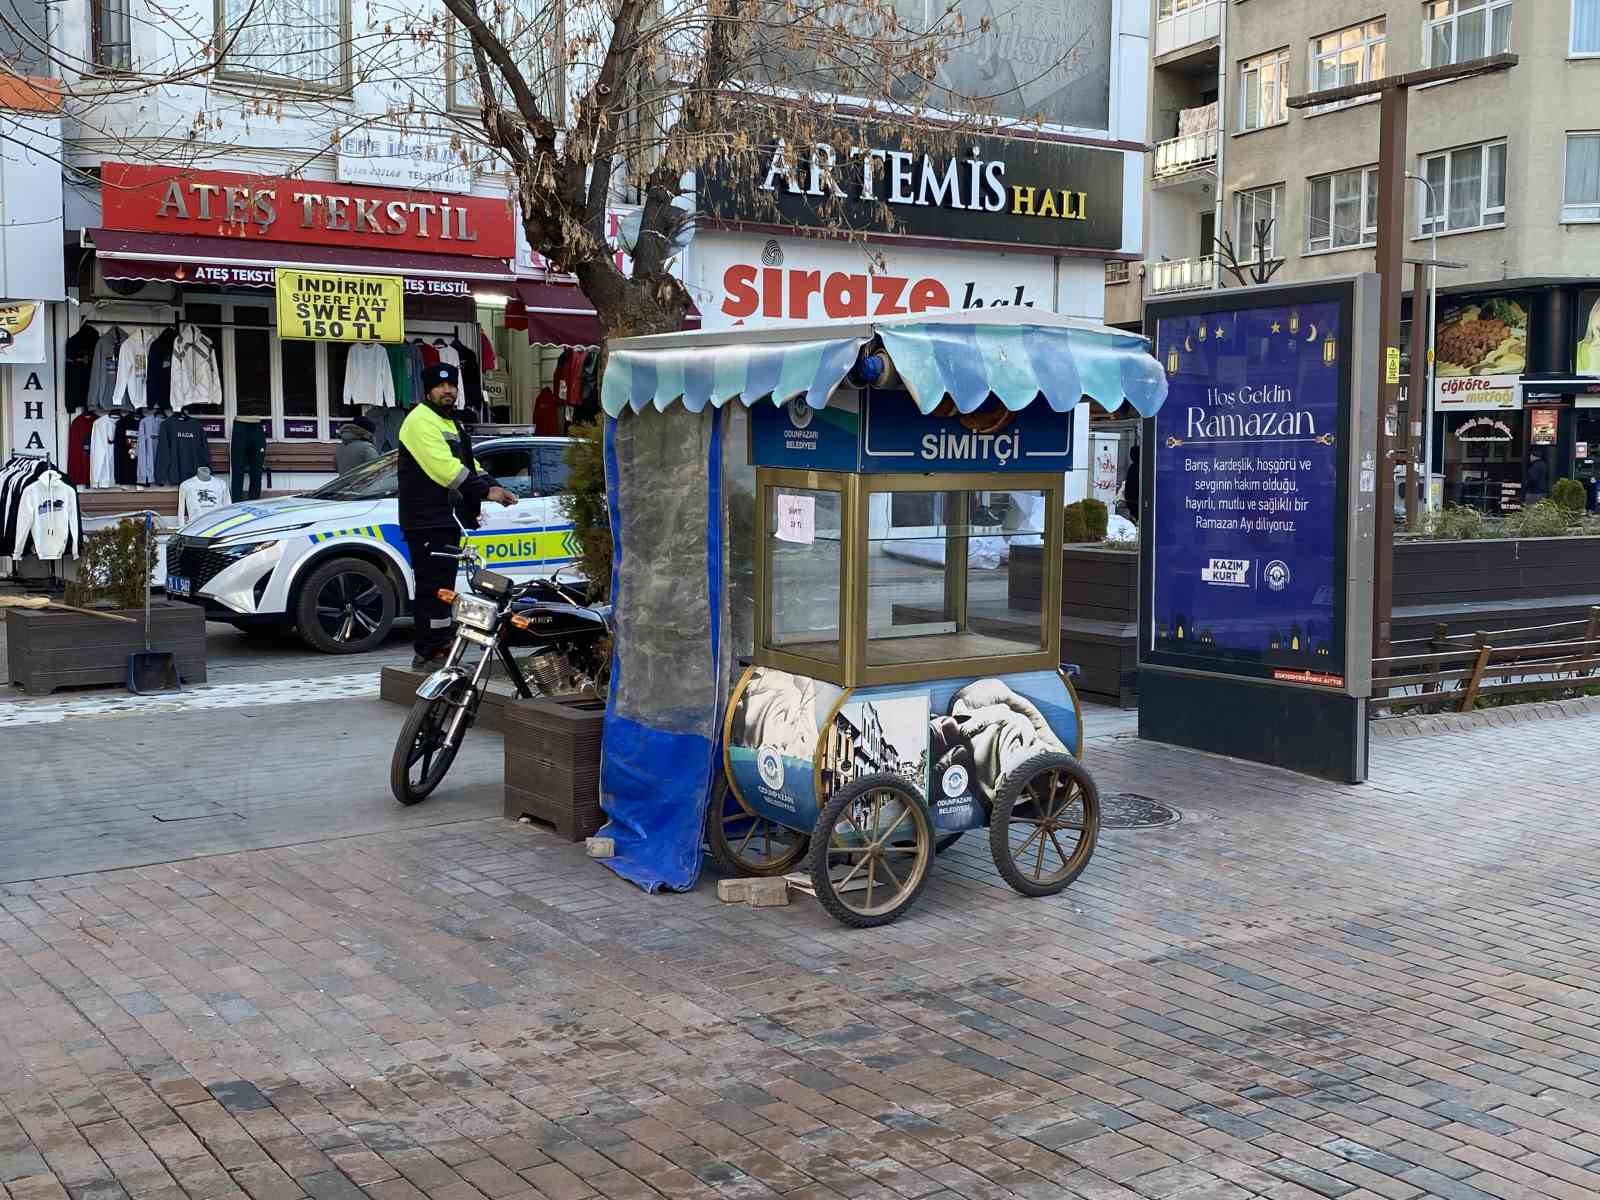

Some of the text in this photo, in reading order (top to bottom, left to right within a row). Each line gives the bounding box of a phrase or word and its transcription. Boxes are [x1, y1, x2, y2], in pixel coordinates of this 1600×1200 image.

[758, 138, 1088, 220] ARTEMİS HALI
[156, 179, 477, 241] ATEŞ TEKSTİL
[195, 267, 275, 283] ATEŞ TEKSTİ
[297, 275, 382, 296] İNDİRİM
[402, 279, 471, 293] TEŞ TEKSTİL
[347, 295, 389, 307] FİYAT
[296, 303, 386, 322] SWEAT
[303, 320, 381, 339] 150 TL
[1208, 384, 1292, 407] Hoş Geldin
[1441, 378, 1490, 395] çiğköfte
[1186, 407, 1316, 438] Ramazan
[920, 428, 1020, 465] SİMİTÇİ
[1185, 457, 1312, 474] Barış, kardeşlik, hoşgörü ve
[1195, 478, 1299, 494] sevginin hakim olduğu,
[1185, 496, 1309, 514] hayırlı, mutlu ve sağlıklı bir
[1195, 515, 1238, 529] Ramazan
[1240, 517, 1254, 533] Ayı
[486, 537, 537, 558] POLİSİ
[1213, 560, 1243, 571] KAZIM
[1212, 571, 1238, 581] KURT
